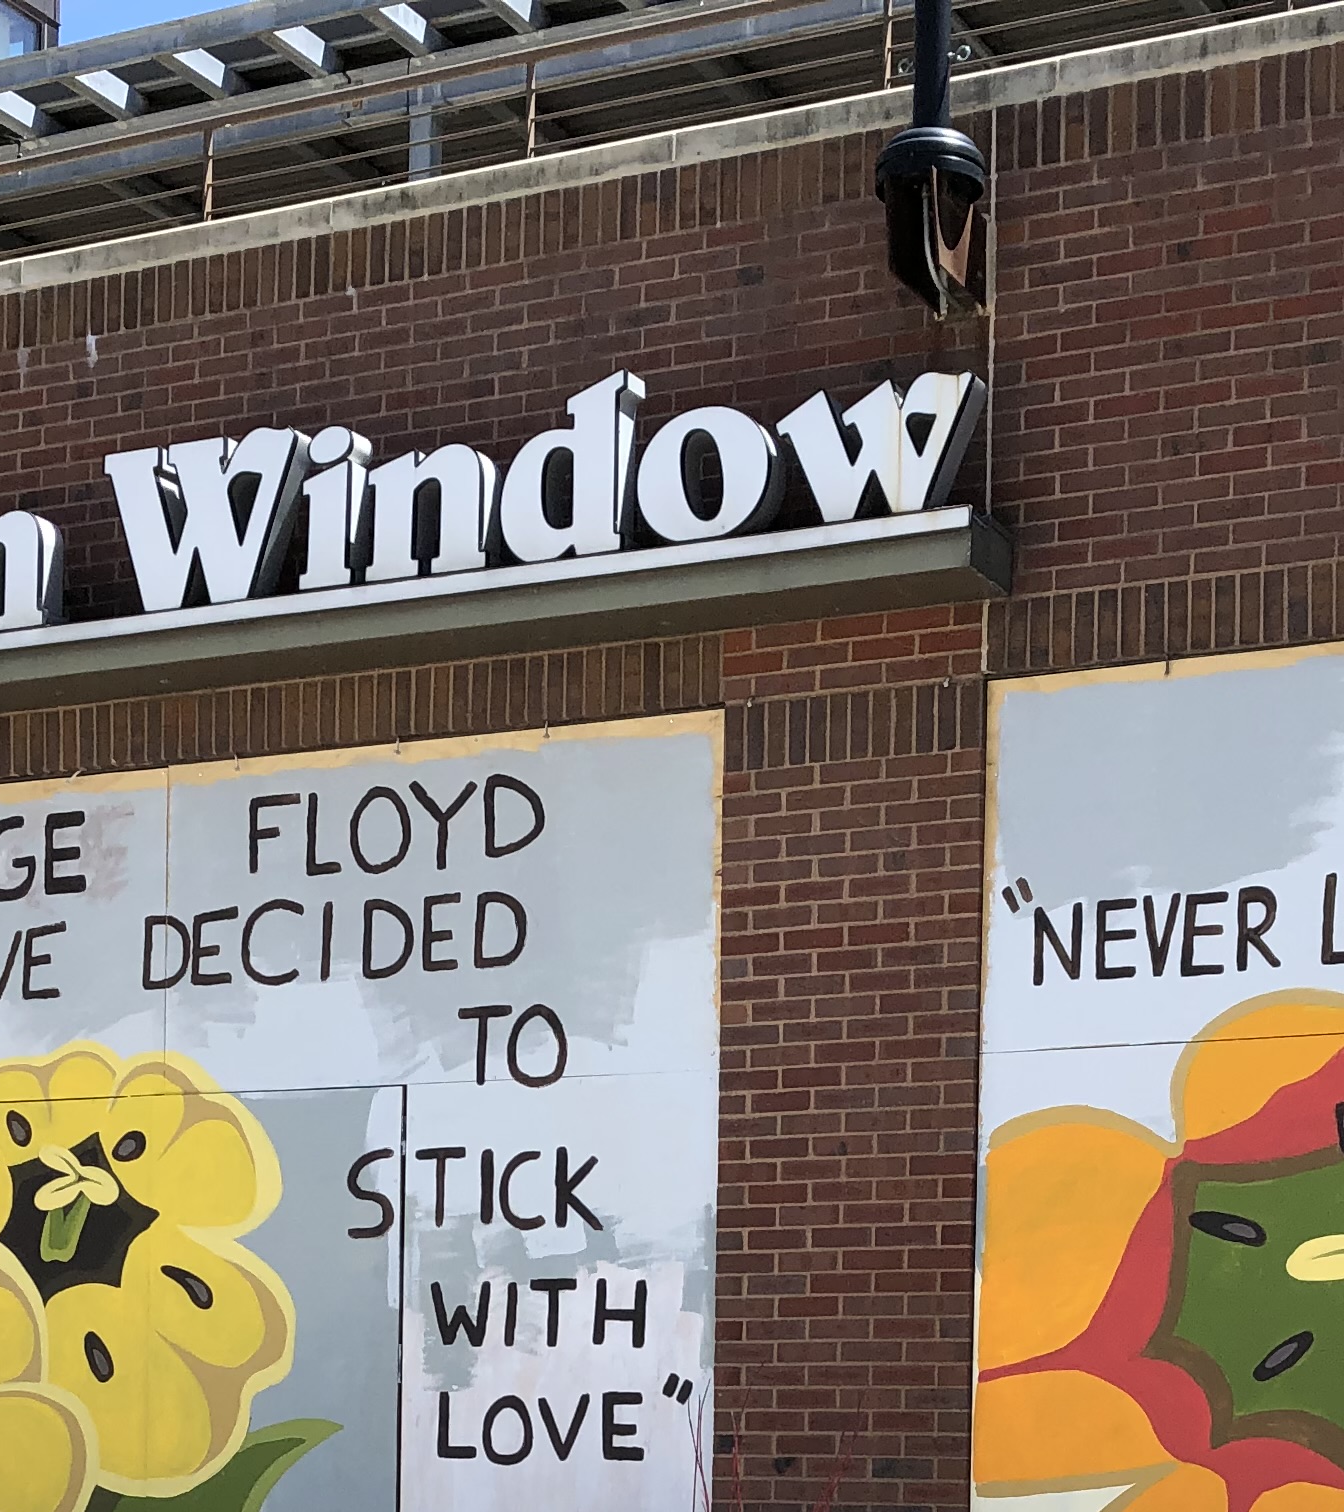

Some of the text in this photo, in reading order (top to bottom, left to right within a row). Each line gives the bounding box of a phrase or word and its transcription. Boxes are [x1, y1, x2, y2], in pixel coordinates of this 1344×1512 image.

[102, 370, 990, 610] Window
[248, 772, 546, 878] FLOYD
[142, 890, 528, 993] DECIDED
[1001, 876, 1282, 987] "NEVER
[457, 1004, 567, 1088] TO
[346, 1146, 605, 1240] STICK
[430, 1278, 648, 1349] WITH
[437, 1372, 694, 1466] LOVE"
